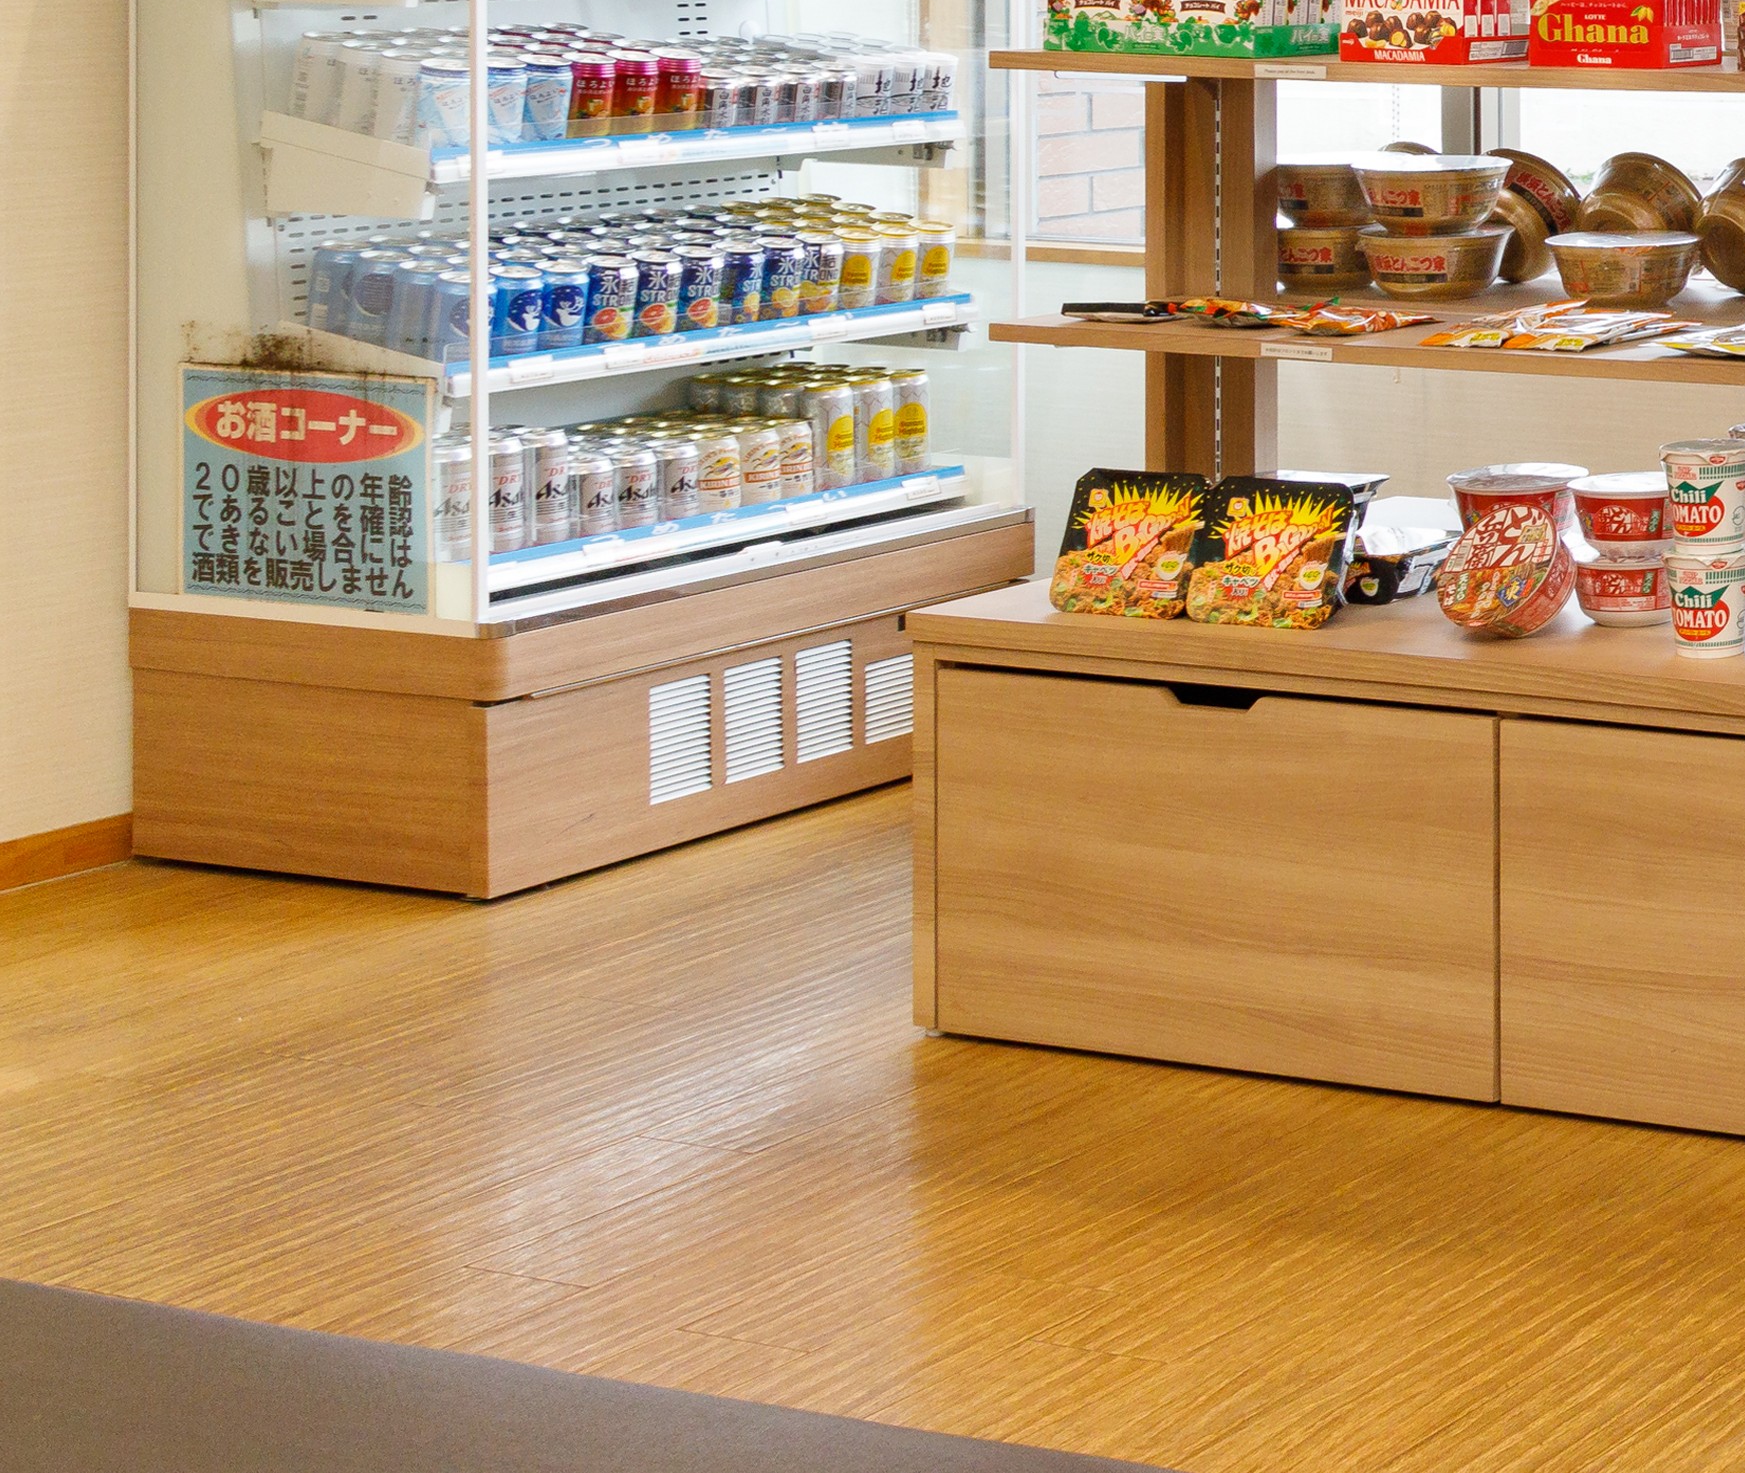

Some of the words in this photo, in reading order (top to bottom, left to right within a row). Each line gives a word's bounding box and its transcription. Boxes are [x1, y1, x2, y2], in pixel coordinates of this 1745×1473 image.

[1537, 13, 1649, 45] Ghana
[1374, 49, 1425, 62] MACADAMIA
[1576, 54, 1612, 65] Ghana
[216, 401, 398, 445] お酒コーナー
[1671, 488, 1707, 503] Chili
[1675, 593, 1712, 608] Chili
